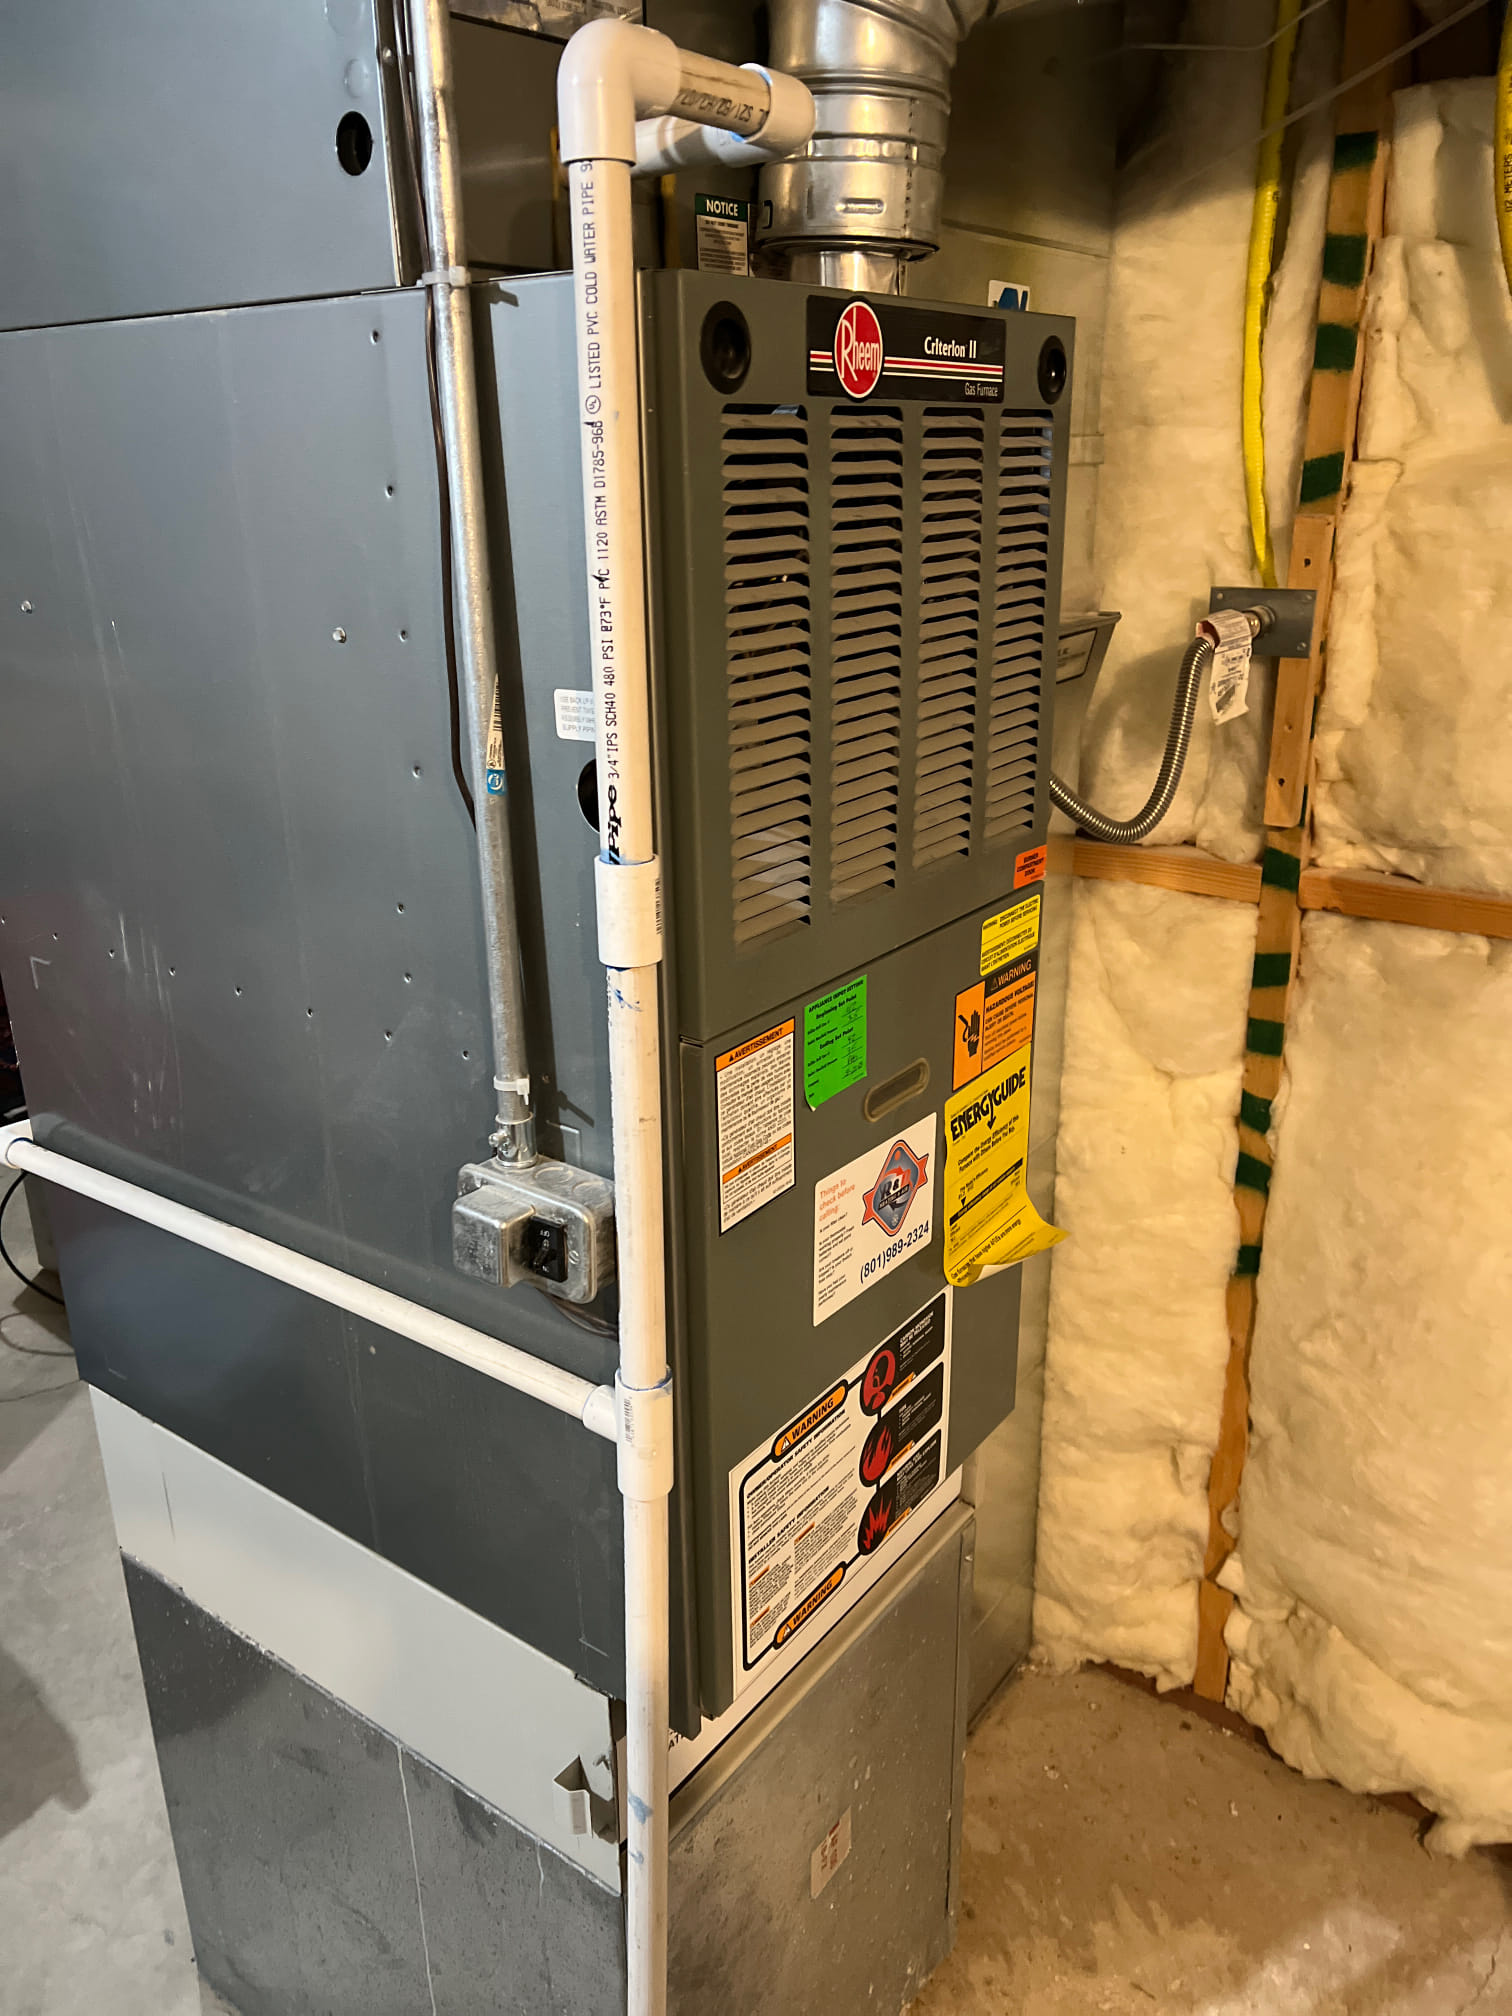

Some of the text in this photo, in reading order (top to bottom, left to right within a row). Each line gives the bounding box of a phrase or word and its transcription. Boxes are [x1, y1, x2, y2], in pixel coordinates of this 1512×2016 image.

[582, 181, 594, 215] PIPE
[706, 199, 738, 217] NOTICE
[584, 222, 597, 264] WATER
[586, 272, 598, 304] COLD
[587, 311, 598, 335] PVC
[840, 306, 880, 382] Rheem
[924, 336, 977, 359] Criterion II
[588, 342, 602, 388] LISTED
[964, 382, 999, 398] Gas Furnace
[596, 496, 610, 526] ASTM
[597, 532, 609, 560] 1120
[602, 639, 617, 660] PSI
[603, 666, 616, 686] 480
[604, 692, 617, 726] SCH40
[998, 959, 1032, 986] WARNING
[808, 995, 831, 1012] APPLIANCE
[986, 992, 1014, 1014] HAZARDOUS
[734, 1028, 782, 1059] AVERTISSEMENT
[950, 1066, 1026, 1142] ENERGYGUIDE
[742, 1145, 778, 1172] AVERTISSEMENT
[819, 1184, 855, 1211] check before
[820, 1182, 839, 1198] Things
[860, 1220, 929, 1284] (801)989-2324
[791, 1398, 834, 1440] WARNING
[794, 1438, 812, 1456] SAFETY
[813, 1409, 846, 1440] INFORMATION
[748, 1486, 830, 1564] INSTALLER SAFETY INFORMATION
[792, 1579, 833, 1626] WARNING
